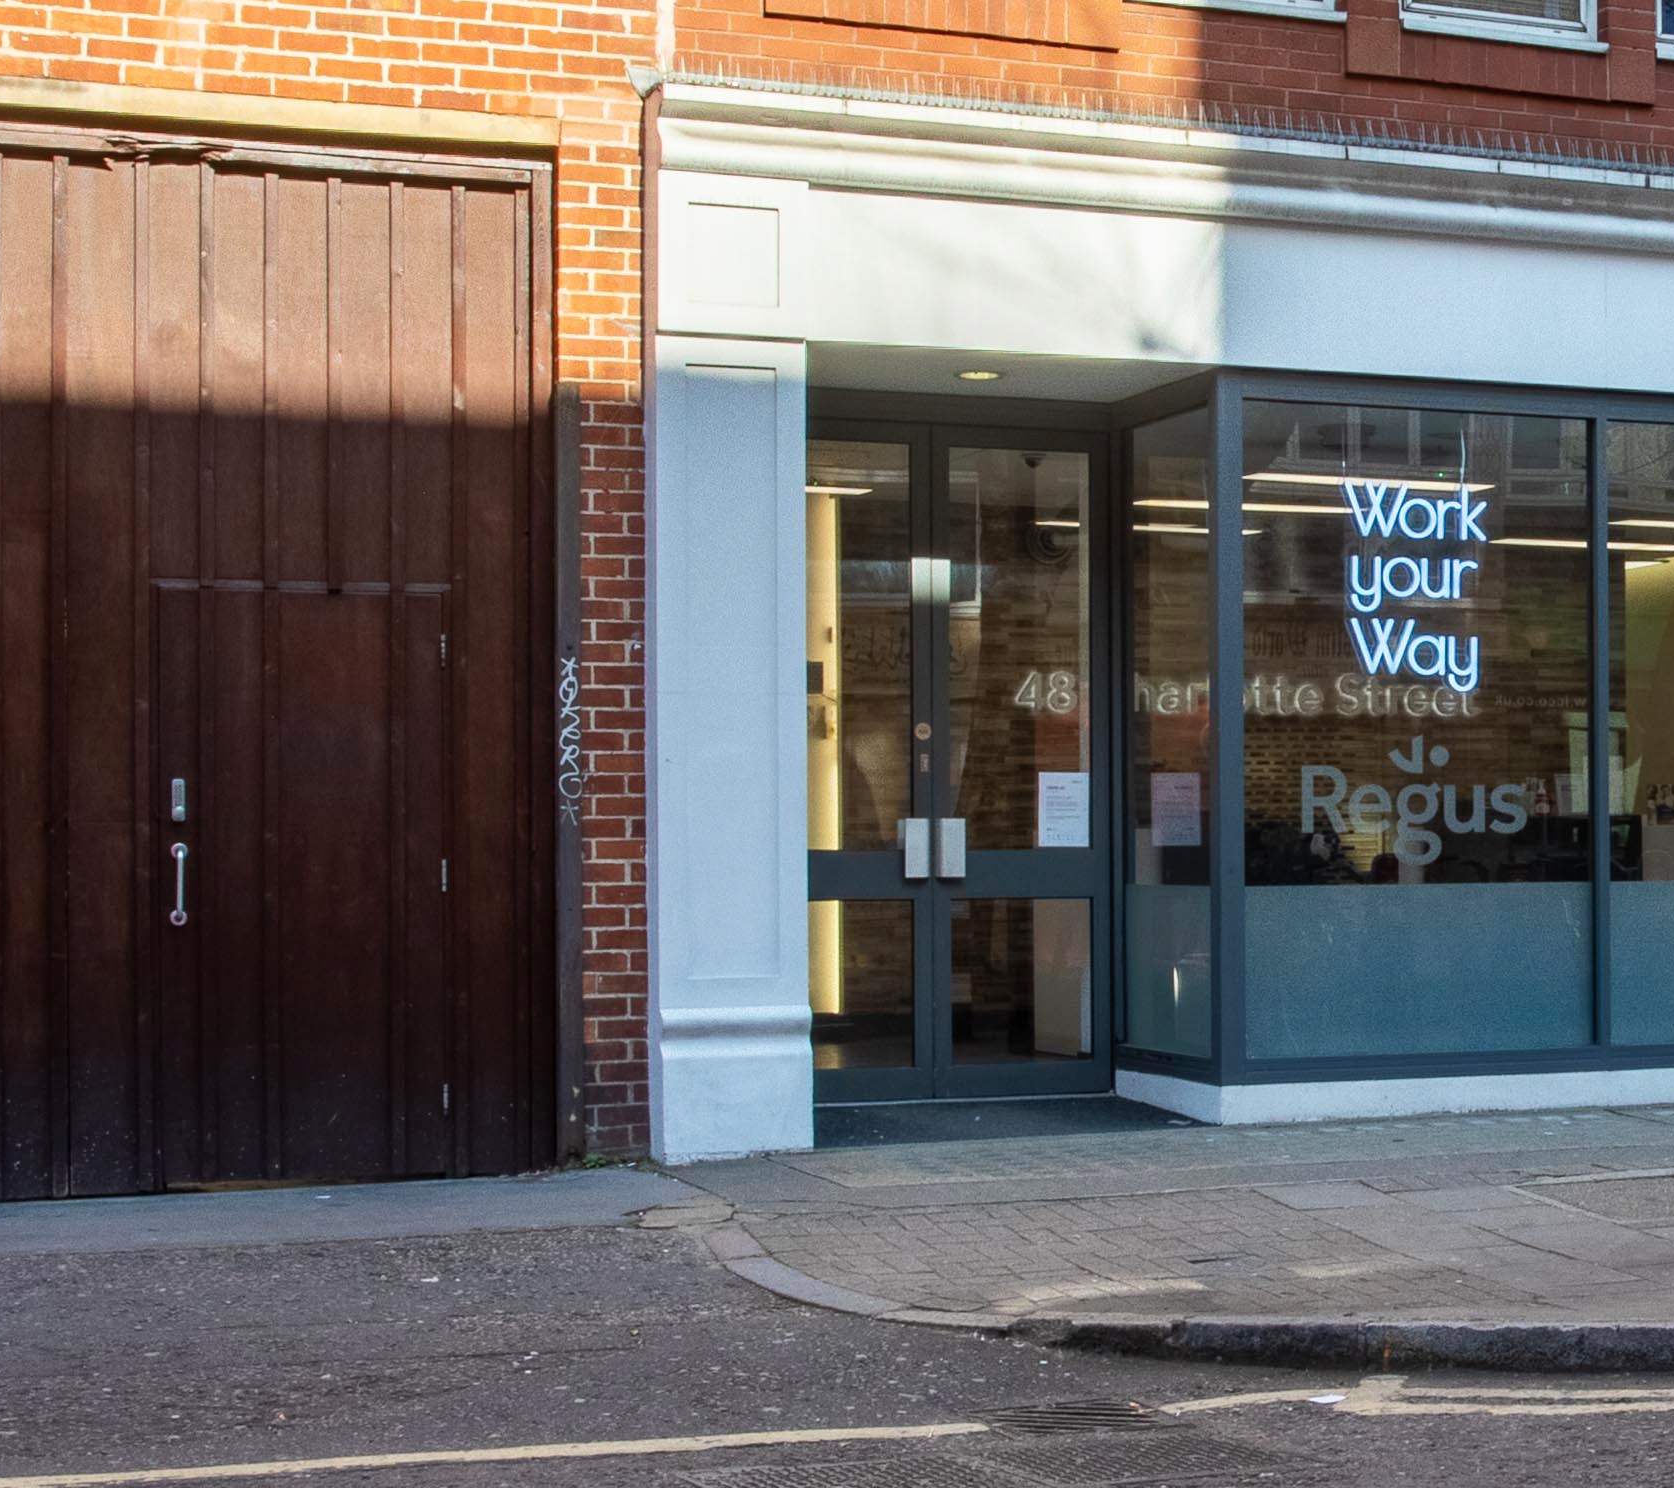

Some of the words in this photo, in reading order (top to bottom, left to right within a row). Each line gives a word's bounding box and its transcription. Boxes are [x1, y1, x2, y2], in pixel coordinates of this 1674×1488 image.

[1343, 480, 1488, 542] Work
[1350, 554, 1479, 613] your
[1350, 617, 1479, 693] Way
[1013, 671, 1078, 714] 48
[1335, 672, 1479, 719] Street
[1300, 764, 1528, 866] Regus
